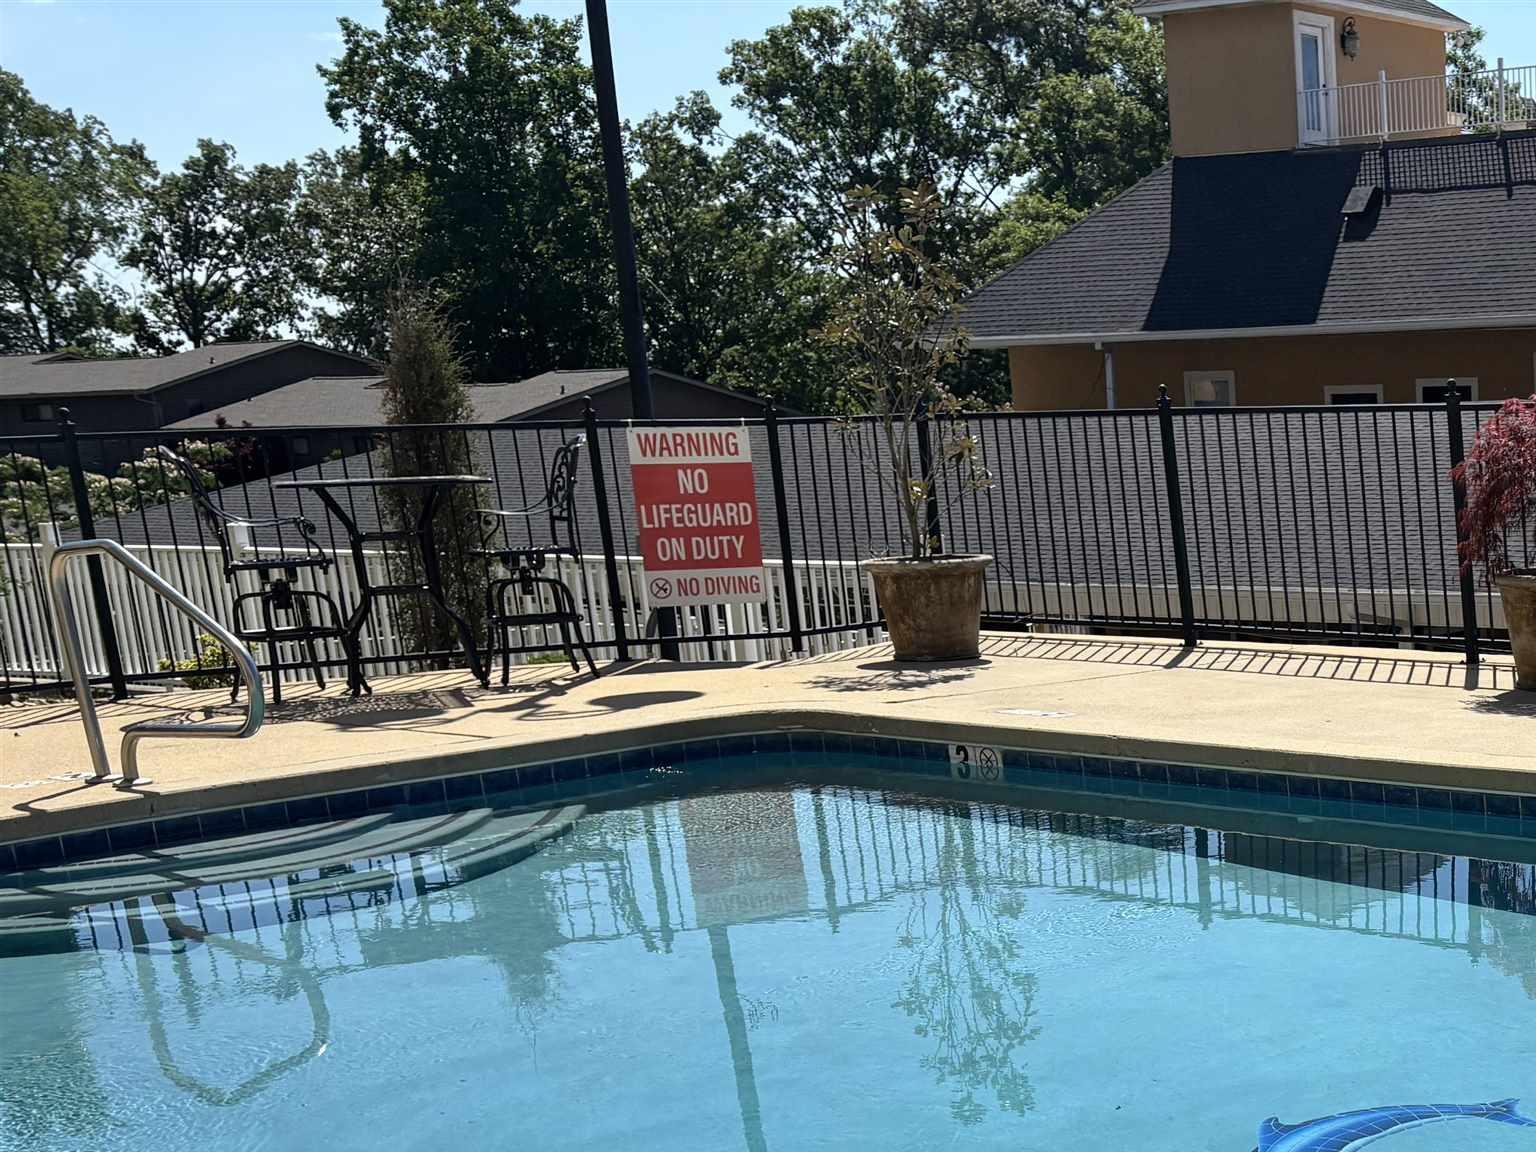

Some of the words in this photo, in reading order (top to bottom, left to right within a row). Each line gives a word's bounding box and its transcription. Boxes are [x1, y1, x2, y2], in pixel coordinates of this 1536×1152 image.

[636, 431, 740, 458] WARNING
[677, 468, 709, 494] NO
[640, 502, 753, 529] LIFEGUARD
[656, 537, 685, 562] ON
[691, 535, 745, 561] DUTY
[676, 577, 700, 597] NO
[704, 575, 761, 596] DIVING
